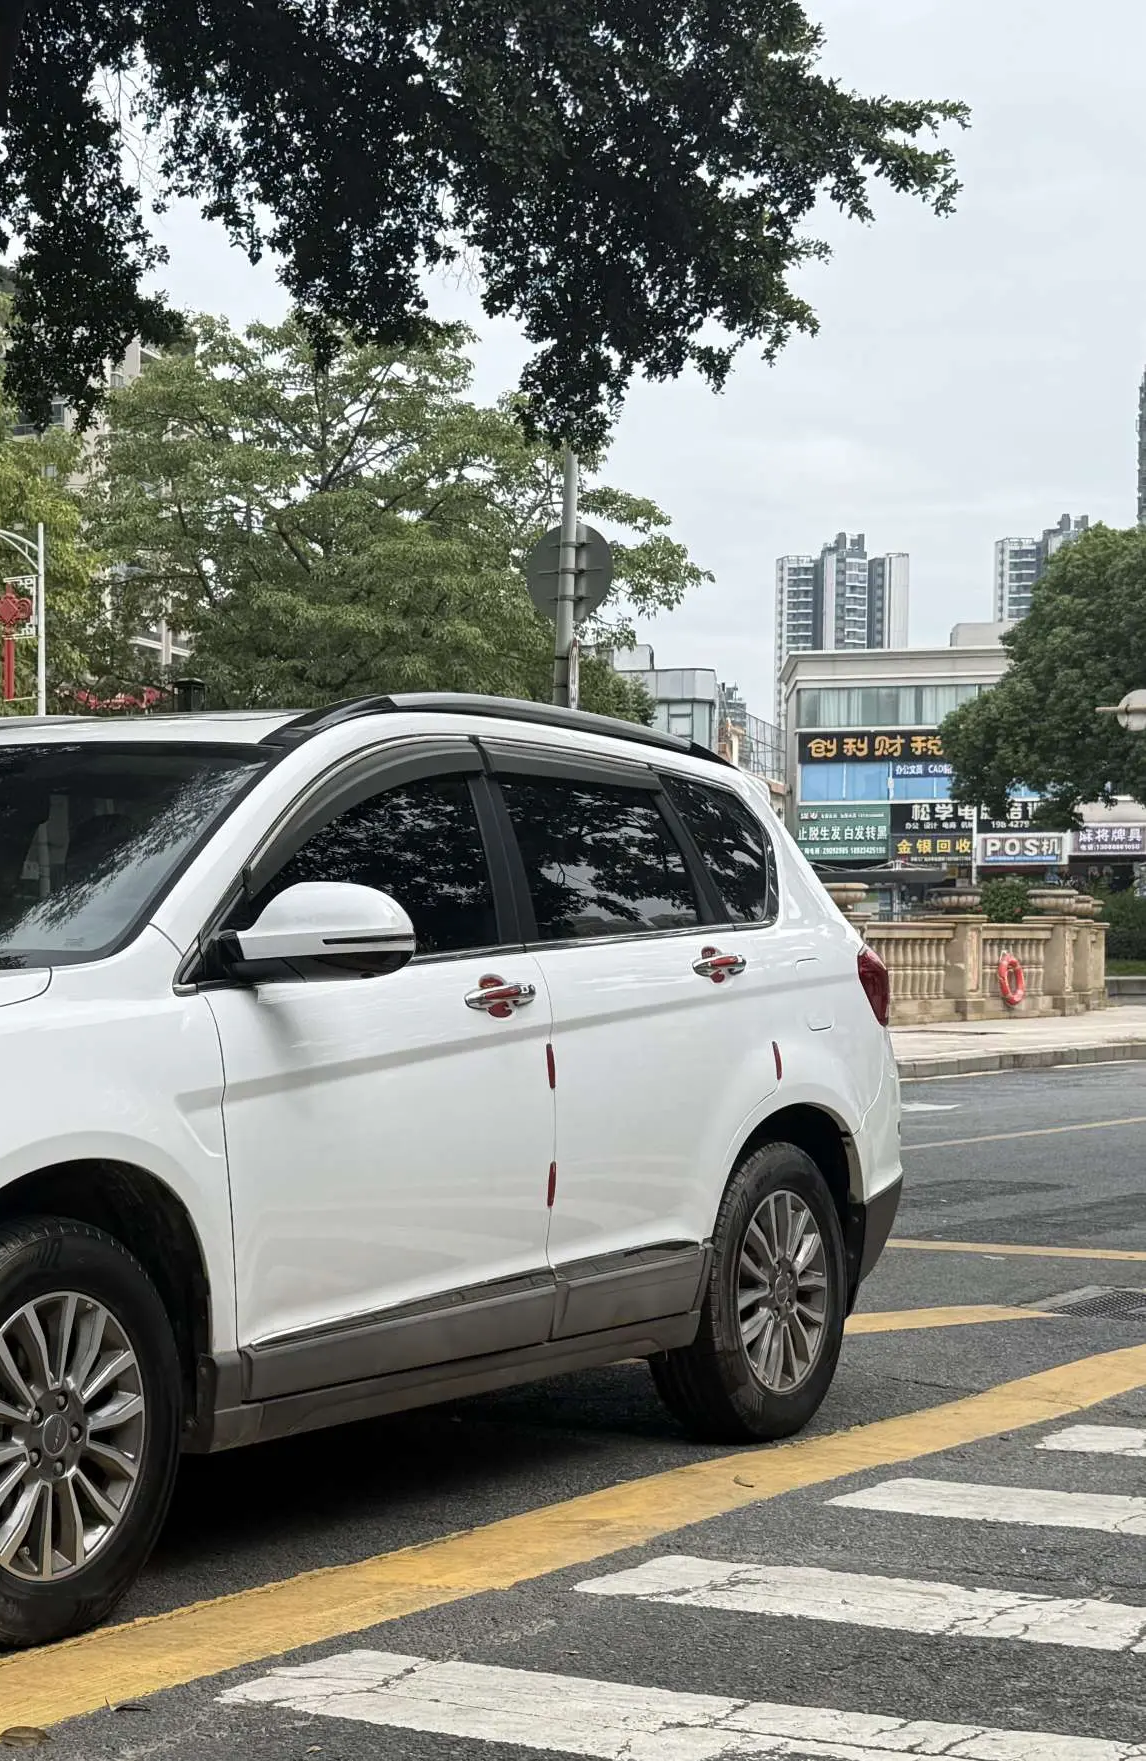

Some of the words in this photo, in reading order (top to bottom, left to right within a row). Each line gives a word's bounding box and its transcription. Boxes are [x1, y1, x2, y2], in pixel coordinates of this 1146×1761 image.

[797, 826, 841, 841] 止脱生发
[844, 825, 888, 840] 白发转黑
[897, 838, 971, 854] 金银回收
[986, 837, 1060, 856] POS机
